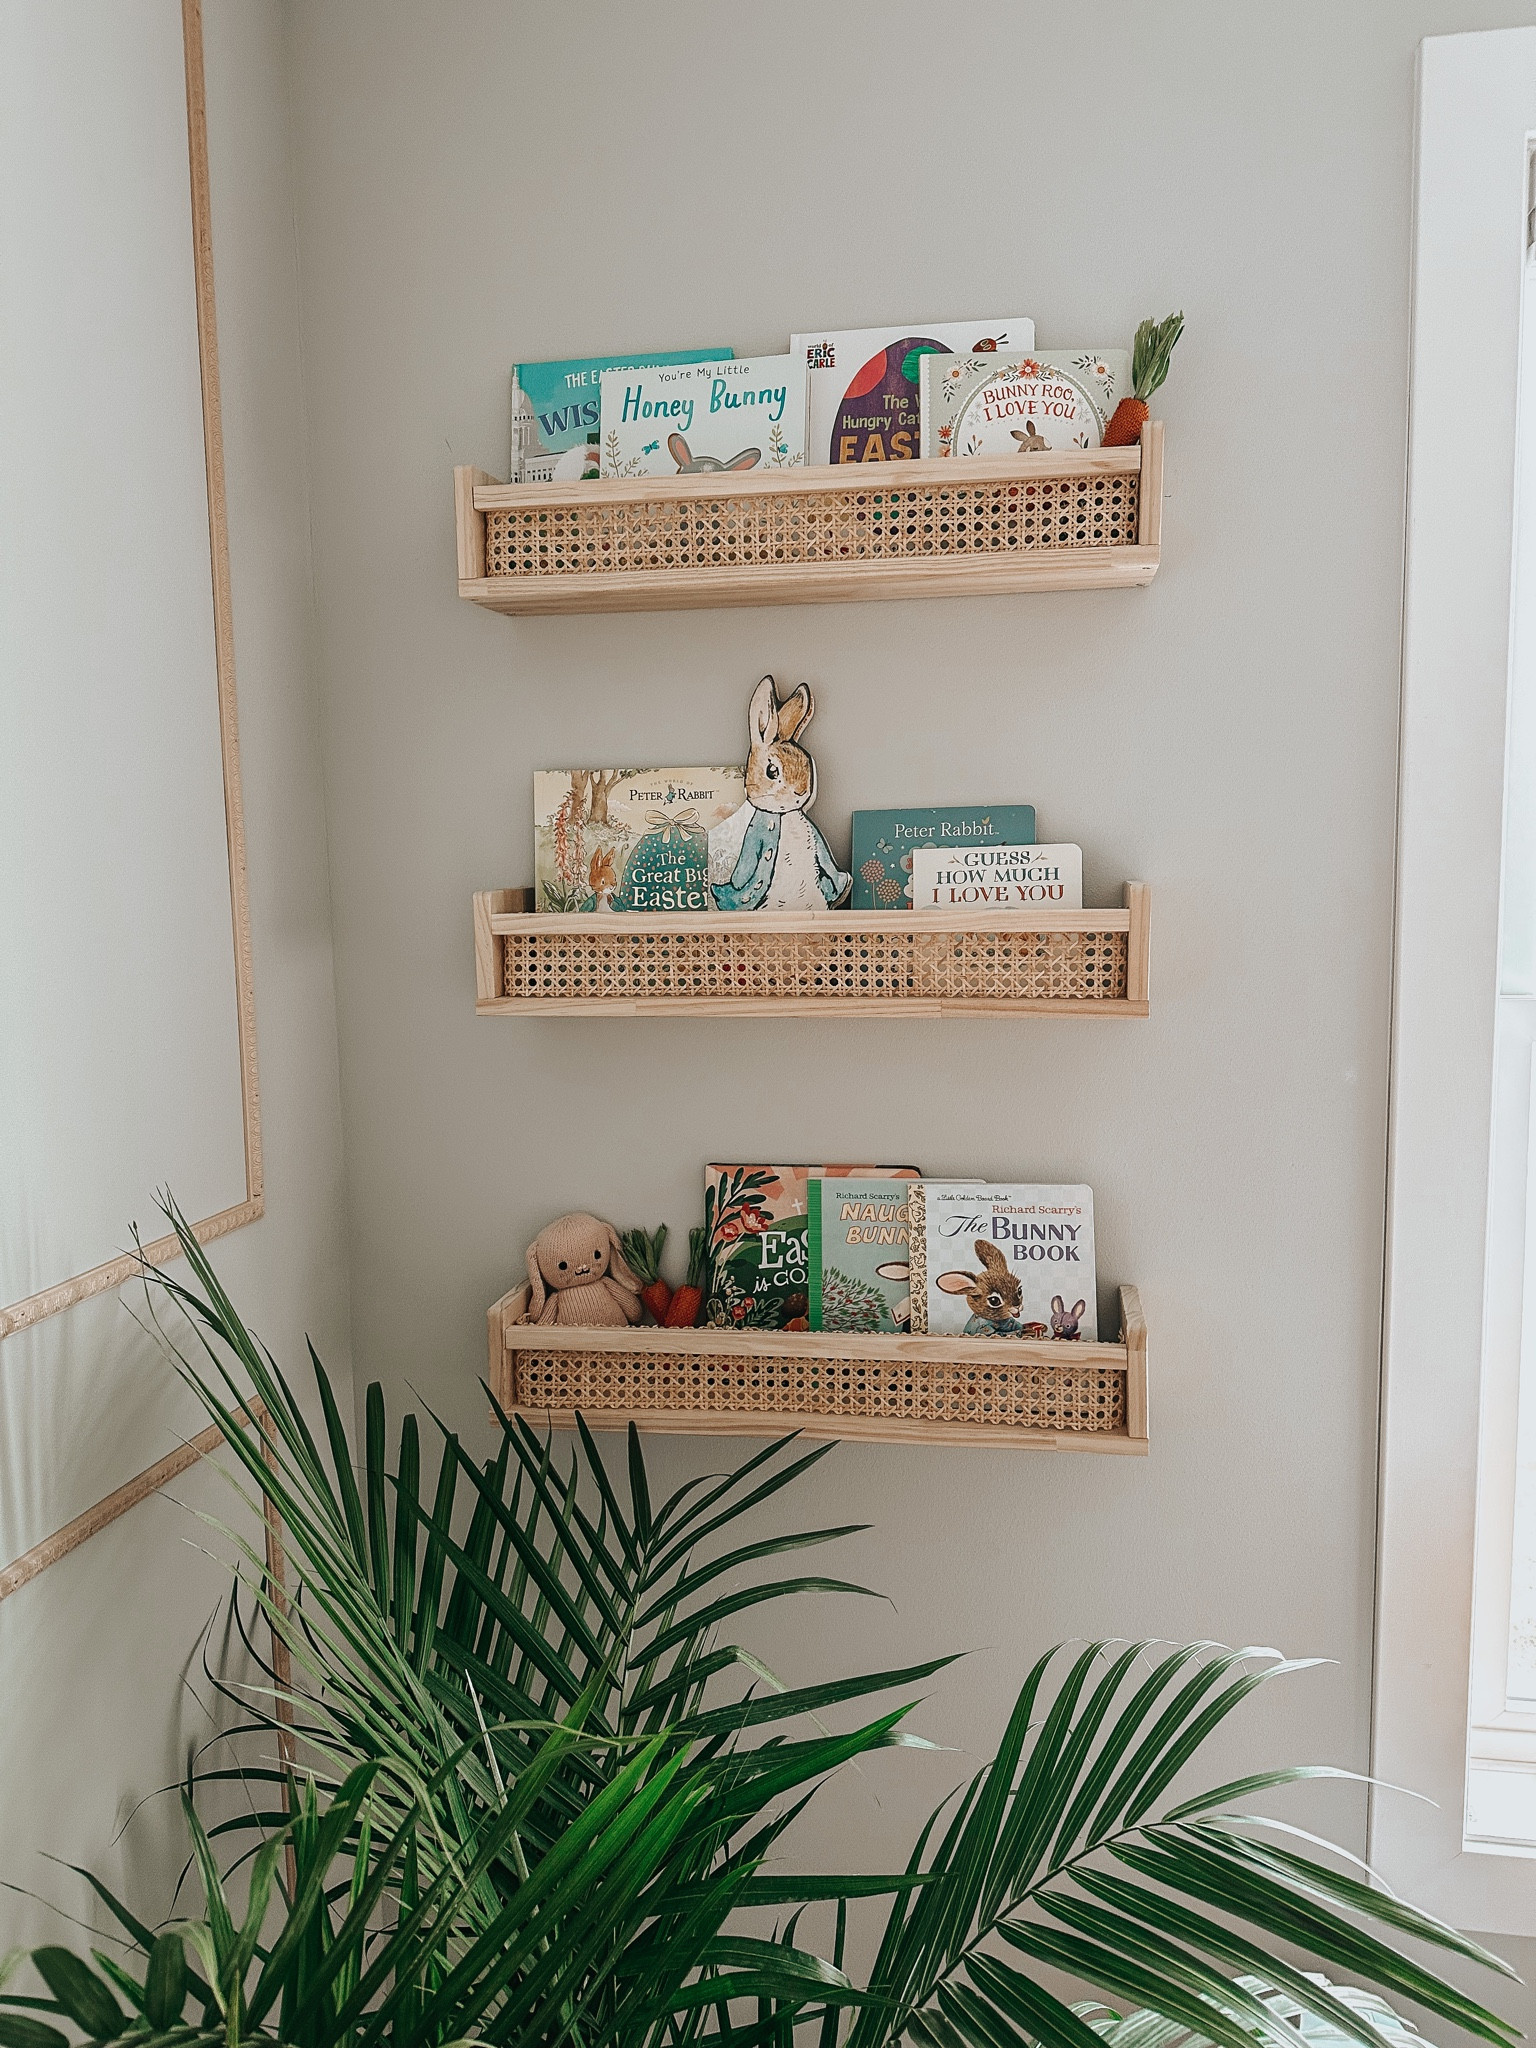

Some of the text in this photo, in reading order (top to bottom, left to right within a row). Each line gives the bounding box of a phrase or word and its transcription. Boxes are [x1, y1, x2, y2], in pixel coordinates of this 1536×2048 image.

[807, 358, 836, 369] CARLE
[564, 371, 588, 389] THE
[658, 365, 750, 382] You're My Little
[883, 394, 909, 410] The
[982, 384, 1075, 404] BUNNY ROO,
[621, 379, 787, 431] Honey Bunny
[983, 400, 1076, 422] I LOVE YOU
[842, 415, 892, 431] Hungry
[839, 431, 920, 464] EAS
[629, 788, 714, 801] PETER RABBIT
[894, 820, 995, 839] Peter Rabbit
[656, 850, 686, 866] The
[963, 850, 1031, 867] GUESS
[631, 868, 681, 884] Great
[936, 867, 1060, 885] HOW MUCH
[932, 884, 1064, 904] I LOVE YOU
[836, 1192, 900, 1201] Richard Scarry's
[955, 1194, 975, 1202] Golden
[992, 1205, 1082, 1216] Richard Scarry's
[938, 1214, 1082, 1241] The BUNNY
[1013, 1244, 1081, 1261] BOOK
[752, 1267, 808, 1294] is CO
